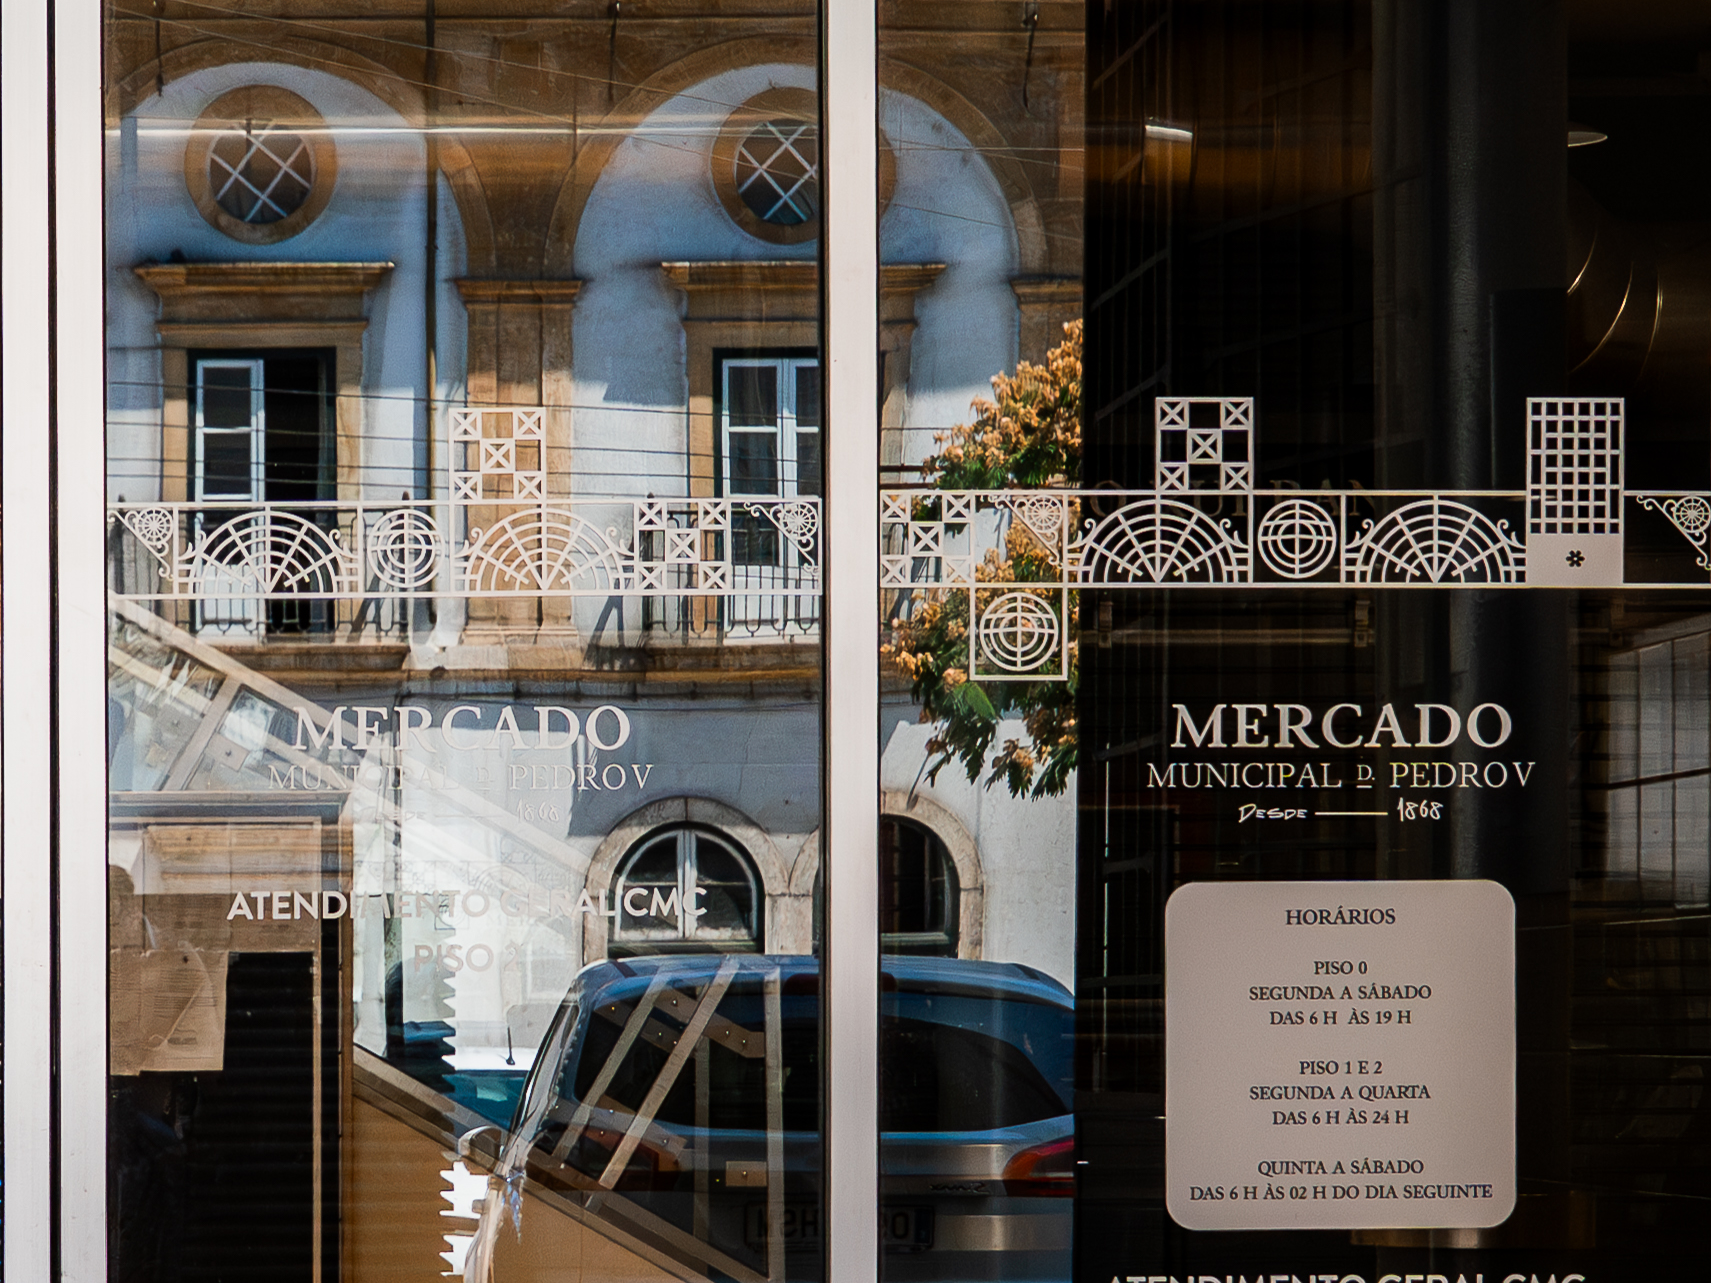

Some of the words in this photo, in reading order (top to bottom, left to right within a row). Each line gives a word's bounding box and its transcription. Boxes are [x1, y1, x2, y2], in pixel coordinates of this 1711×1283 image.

[293, 704, 632, 752] MERCADO
[1170, 702, 1512, 749] MERCADO
[268, 763, 461, 792] MUNICIPAL
[509, 763, 628, 792] PEDRO
[632, 763, 655, 791] V
[1147, 762, 1343, 789] MUNICIPAL
[1389, 761, 1508, 789] PEDRO
[1512, 761, 1536, 787] V
[1396, 796, 1444, 822] 1868
[227, 888, 489, 922] ATENDIMENTO
[499, 888, 616, 919] GERAL
[624, 886, 708, 918] CMC
[1285, 905, 1396, 926] HORÁRIOS
[413, 943, 494, 973] PISO
[503, 942, 522, 972] 2
[1313, 960, 1354, 976] PISO
[1358, 960, 1368, 975] 0
[1249, 985, 1335, 1001] SEGUNDA
[1339, 985, 1353, 1000] A
[1357, 982, 1432, 1000] SÁBADO
[1269, 1010, 1305, 1026] DAS
[1309, 1011, 1319, 1025] 6
[1323, 1010, 1338, 1025] H
[1347, 1007, 1370, 1025] ÀS
[1375, 1010, 1393, 1025] 19
[1397, 1009, 1412, 1025] H
[1299, 1060, 1340, 1075] PISO
[1345, 1060, 1352, 1075] 1
[1357, 1060, 1370, 1075] E
[1373, 1060, 1383, 1075] 2
[1249, 1085, 1336, 1101] SEGUNDA
[1340, 1085, 1354, 1100] A
[1358, 1084, 1431, 1102] QUARTA
[1272, 1110, 1308, 1126] DAS
[1311, 1111, 1321, 1125] 6
[1325, 1110, 1340, 1125] H
[1345, 1107, 1368, 1125] ÀS
[1372, 1110, 1390, 1125] 24
[1395, 1109, 1409, 1125] H
[1257, 1160, 1328, 1178] QUINTA
[1331, 1160, 1346, 1175] A
[1350, 1157, 1425, 1175] SÁBADO
[1189, 1185, 1225, 1201] DAS
[1229, 1186, 1239, 1200] 6
[1243, 1185, 1258, 1200] H
[1262, 1182, 1285, 1200] ÀS
[1289, 1186, 1307, 1200] 02
[1312, 1185, 1327, 1200] H
[1332, 1185, 1360, 1200] DO
[1365, 1184, 1399, 1199] DIA
[1403, 1183, 1493, 1200] SEGUINTE
